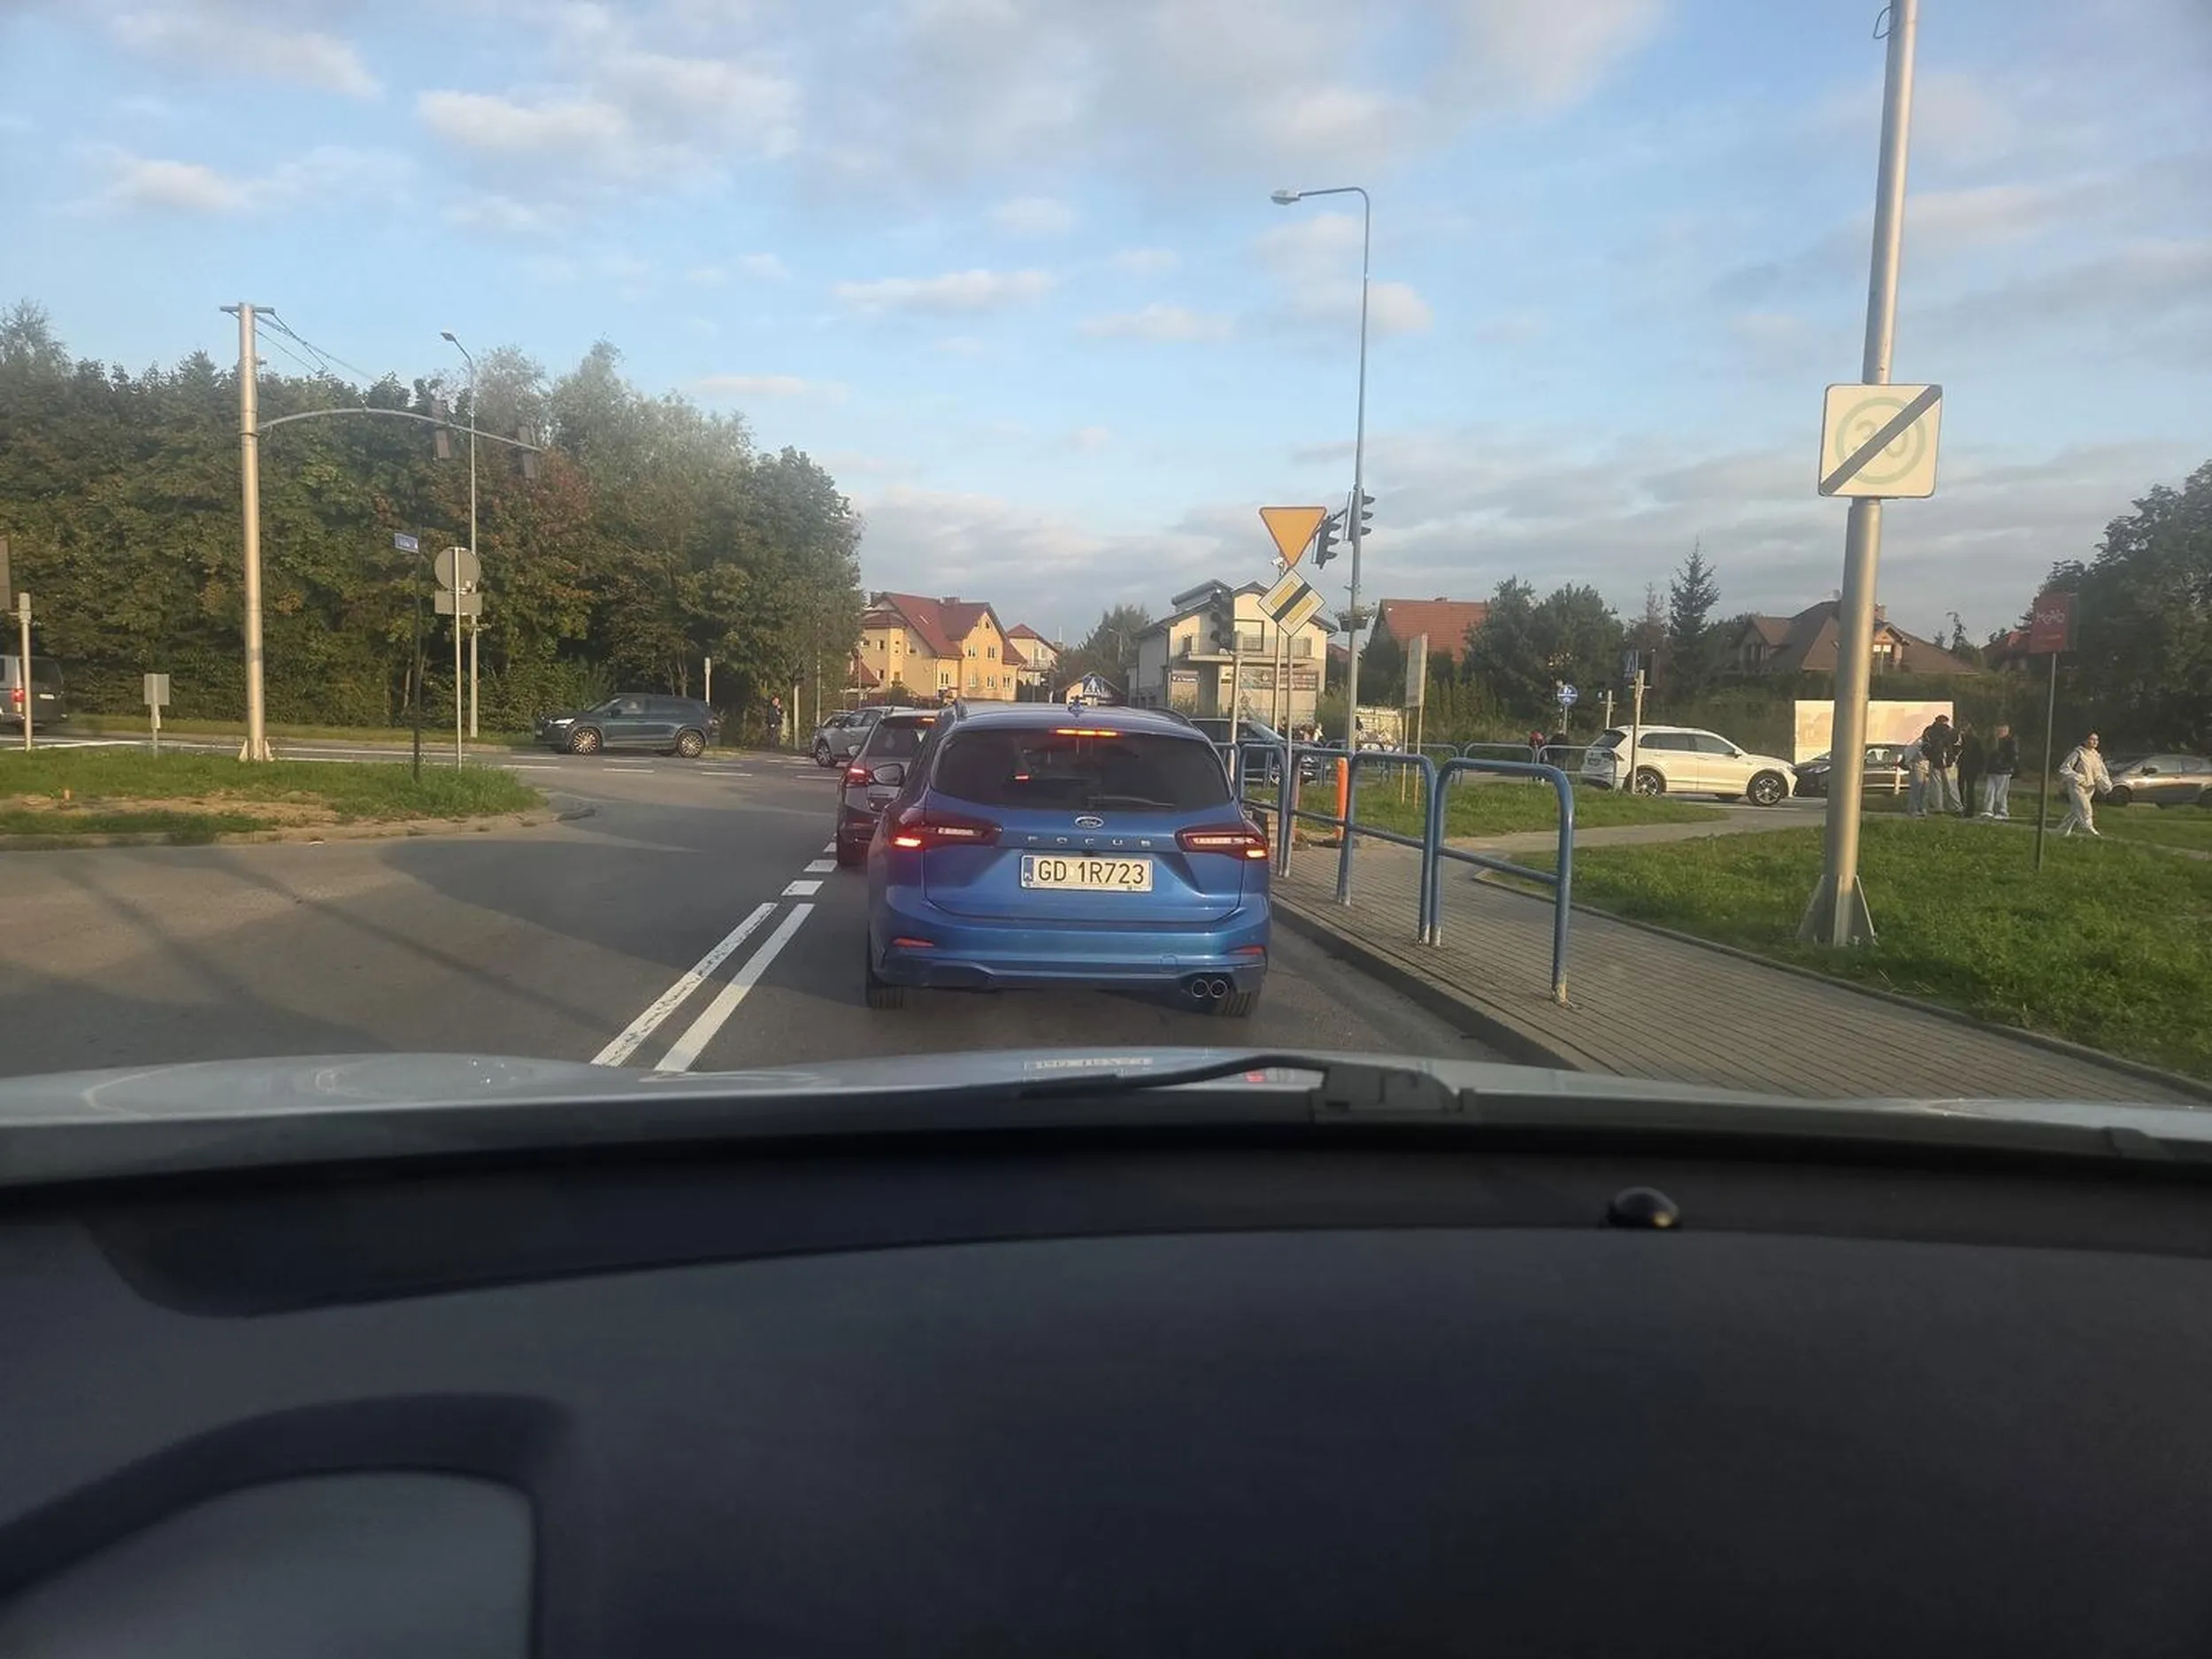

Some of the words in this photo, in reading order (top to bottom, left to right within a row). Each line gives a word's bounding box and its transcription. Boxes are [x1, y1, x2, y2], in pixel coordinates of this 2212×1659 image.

[1027, 835, 1151, 846] FOCUS
[1038, 859, 1067, 881] GD
[1078, 861, 1144, 885] 1R723
